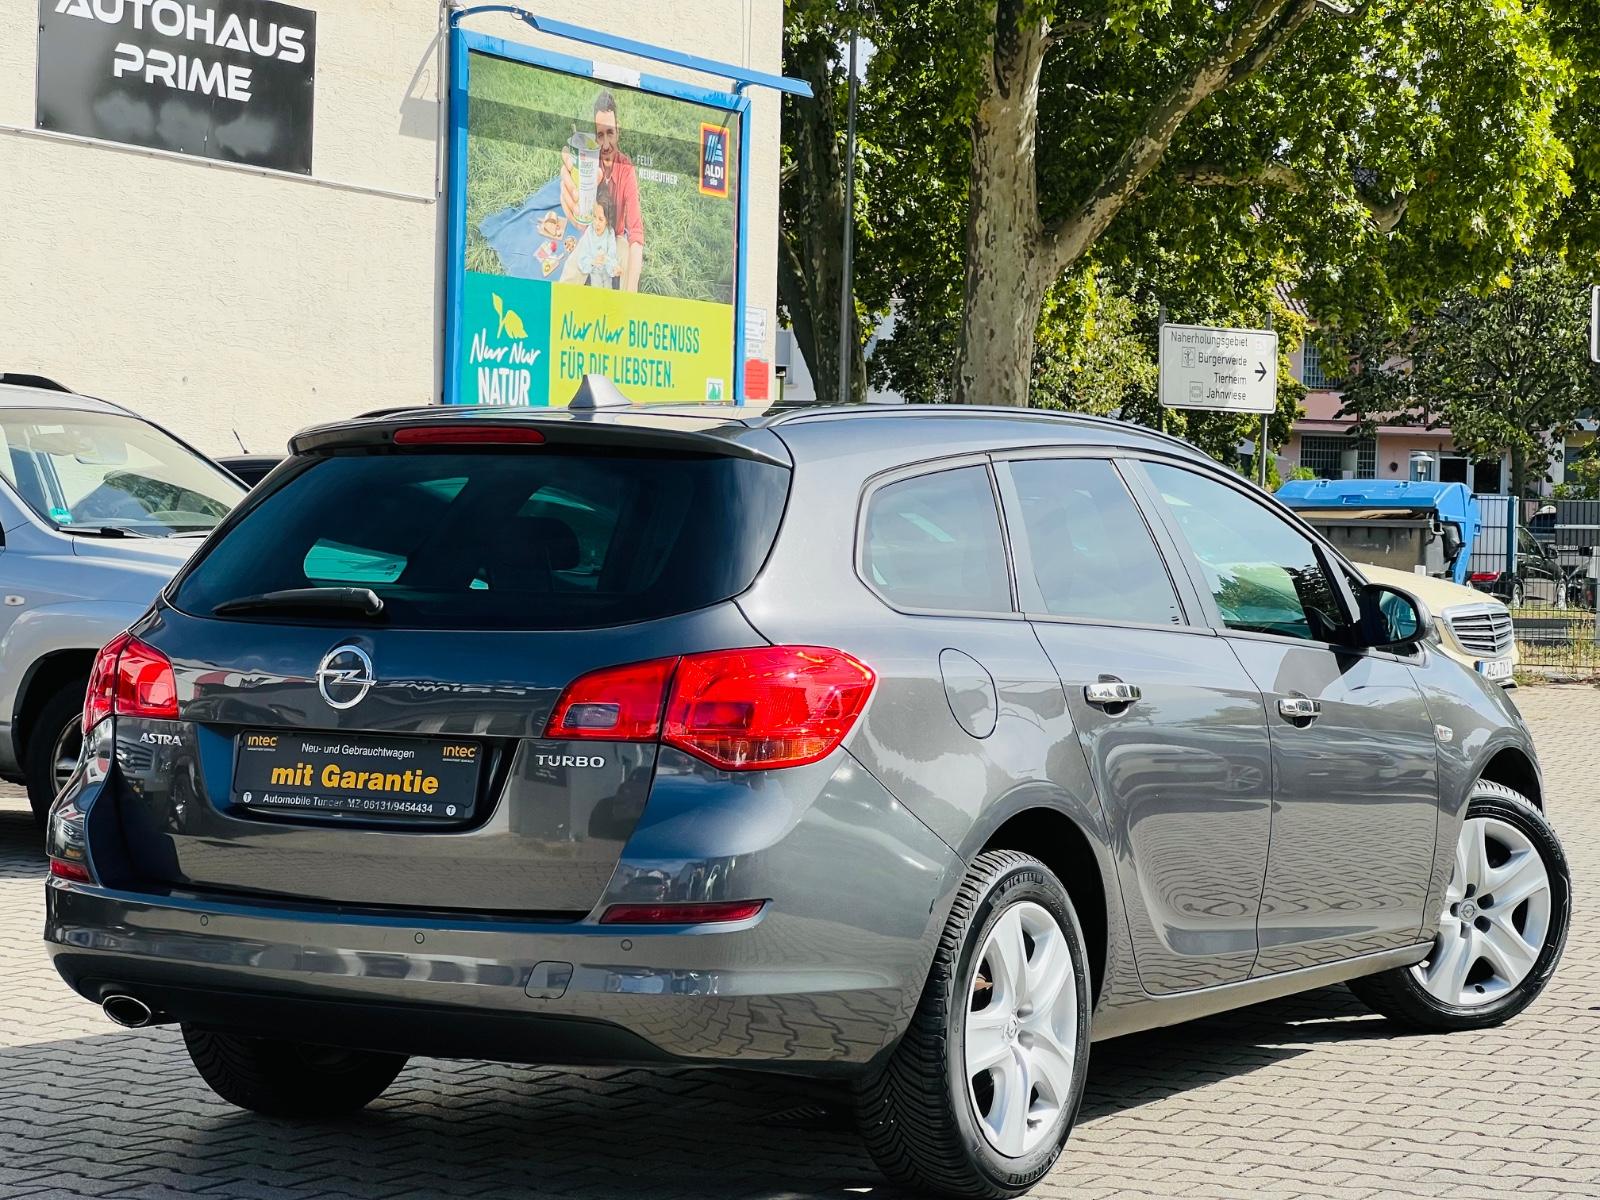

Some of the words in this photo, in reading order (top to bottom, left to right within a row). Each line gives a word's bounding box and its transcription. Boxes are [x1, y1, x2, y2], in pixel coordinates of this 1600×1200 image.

[114, 42, 253, 102] PRIME
[639, 167, 678, 185] NEUREUTHER
[705, 163, 724, 180] ALDI
[560, 310, 592, 342] Nur
[593, 314, 624, 345] Nur
[628, 319, 700, 354] BIO-GENUSS
[1171, 331, 1248, 349] Naherholungsgebiet
[469, 328, 508, 364] Nur
[509, 341, 541, 366] Nur
[560, 346, 584, 380] FÜR
[613, 355, 675, 389] LIEBSTEN.
[1198, 351, 1247, 367] Bürgerweide
[478, 366, 531, 406] NATUR
[1214, 372, 1247, 385] Tierheim
[1206, 387, 1247, 401] Jahnwiese
[139, 732, 182, 747] ASTRA
[247, 735, 278, 747] intec
[302, 743, 321, 753] Neu-
[324, 744, 340, 754] und
[341, 744, 415, 760] Gebrauchtwagen
[442, 745, 476, 758] intec
[536, 754, 605, 768] TURBO
[271, 762, 313, 786] mit
[321, 764, 439, 795] Garantie
[262, 793, 311, 806] Automobile
